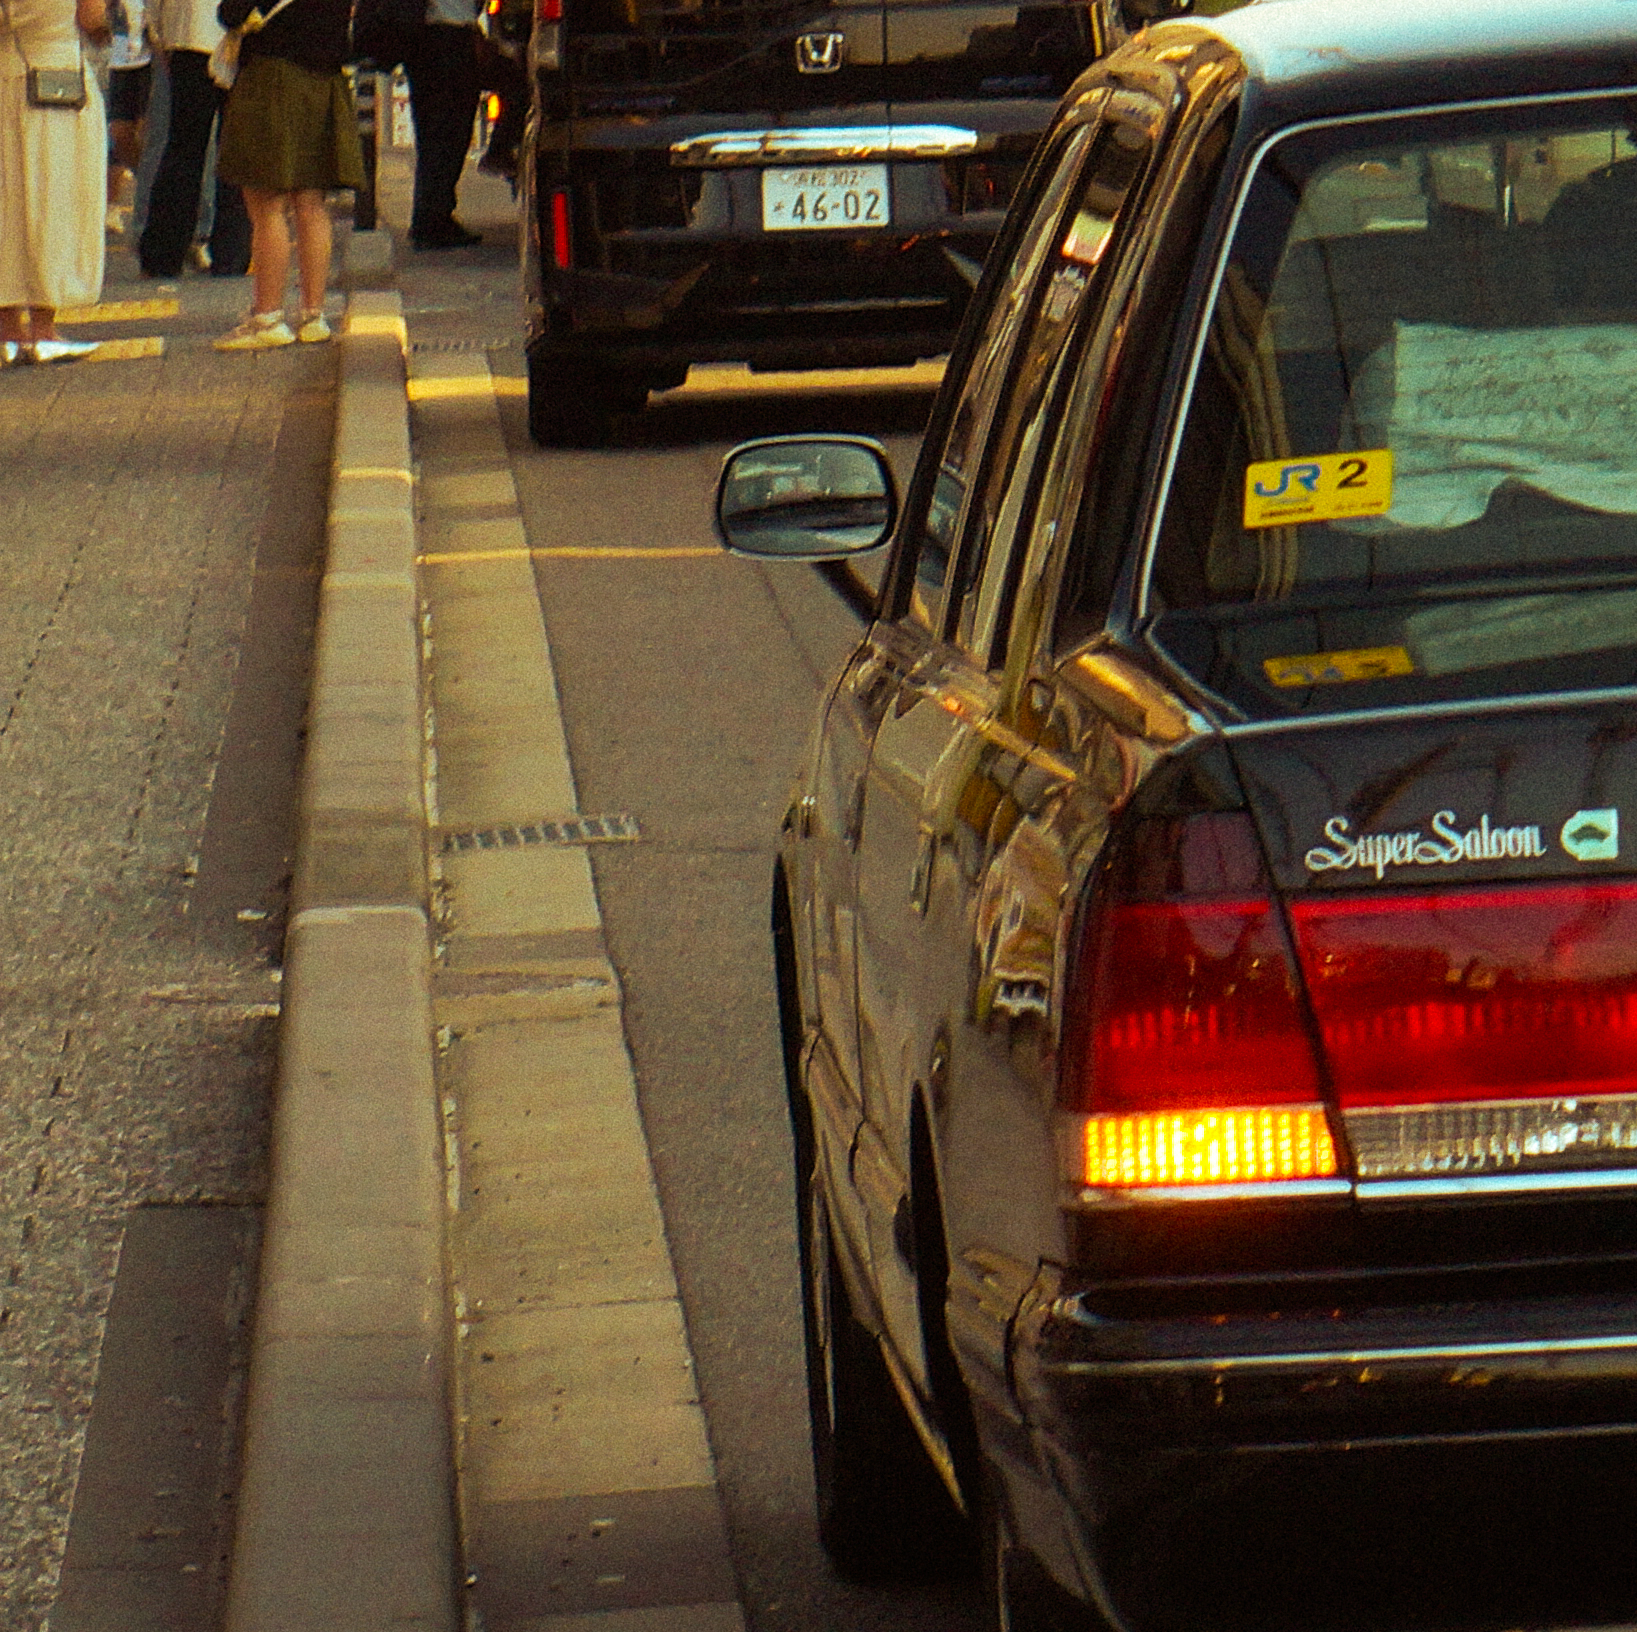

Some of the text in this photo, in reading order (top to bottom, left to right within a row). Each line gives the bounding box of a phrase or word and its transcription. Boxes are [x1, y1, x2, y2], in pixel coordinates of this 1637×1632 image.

[792, 189, 880, 222] 46-02
[1254, 458, 1368, 497] JR 2
